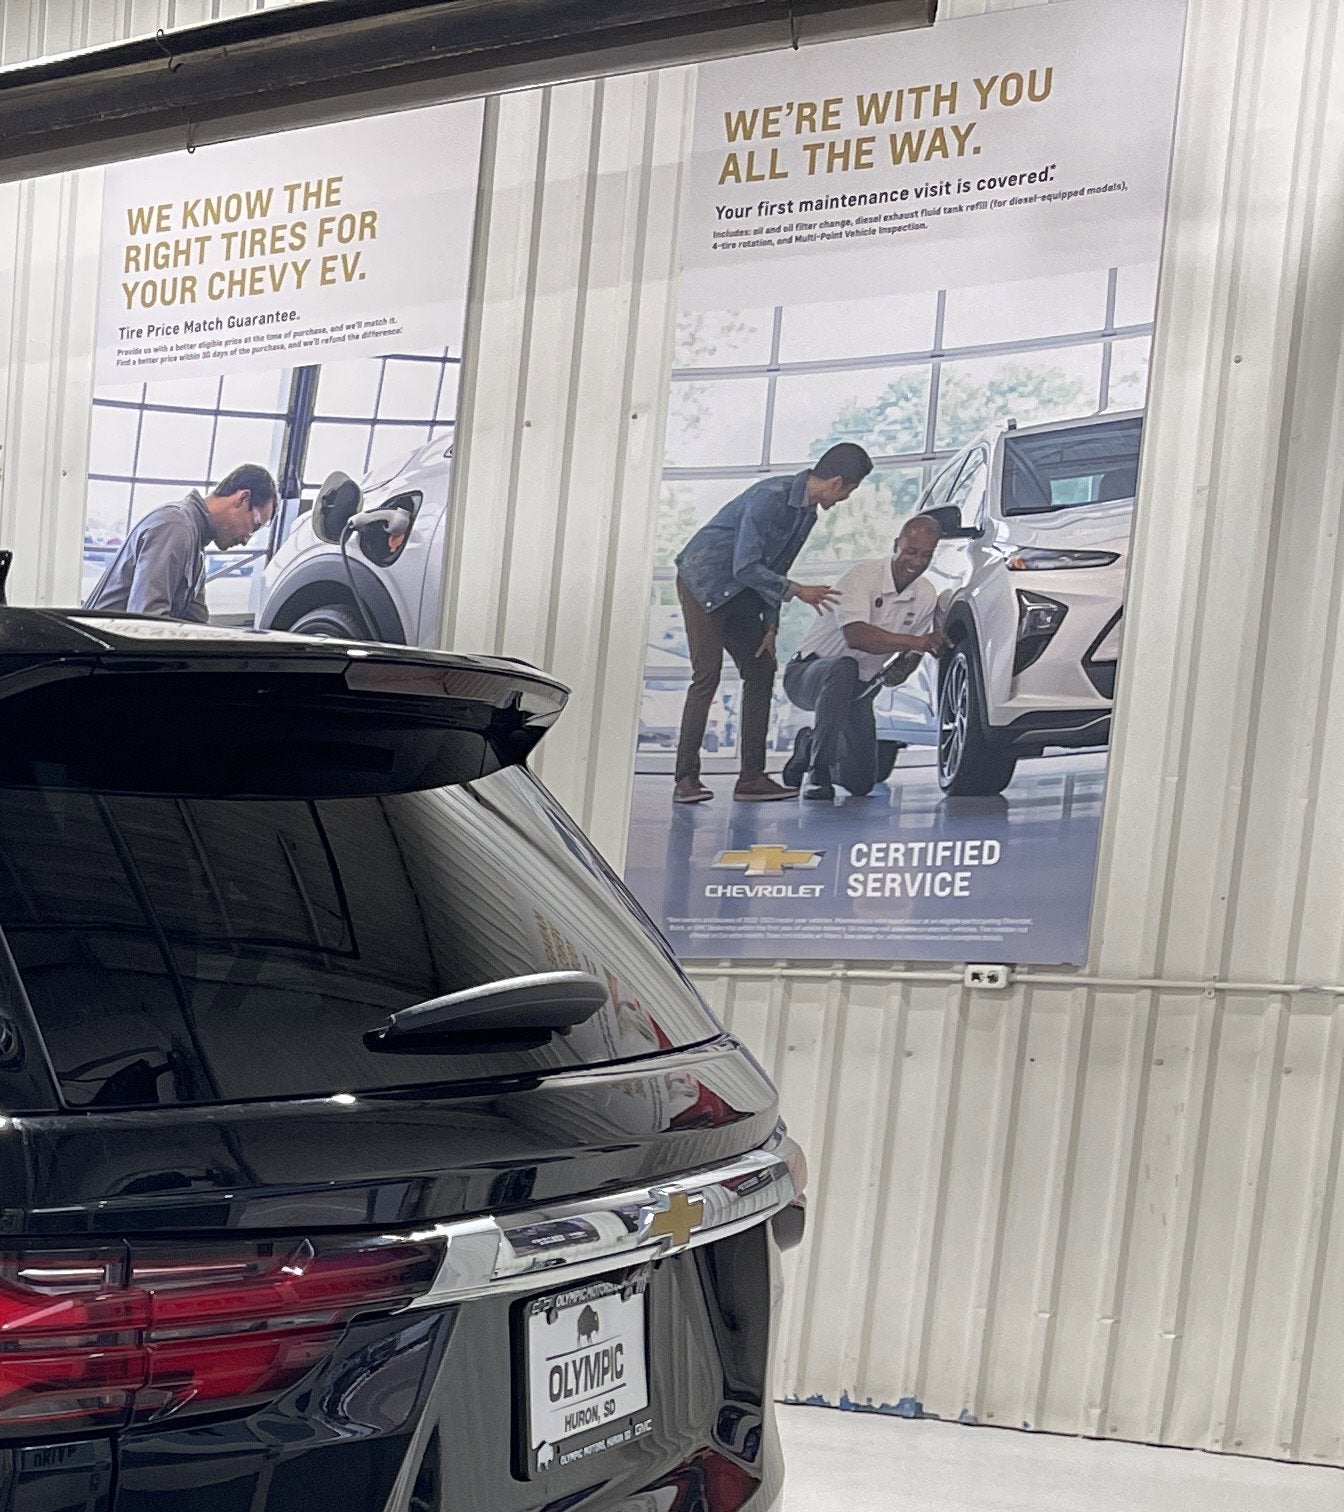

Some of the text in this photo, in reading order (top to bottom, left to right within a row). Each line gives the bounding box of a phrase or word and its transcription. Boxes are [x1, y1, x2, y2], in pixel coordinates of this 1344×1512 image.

[724, 66, 1053, 143] WE'RE WITH YOU
[718, 122, 981, 185] ALL THE WAY.
[127, 176, 343, 236] WE KNOW THE
[716, 205, 753, 220] Your
[757, 200, 794, 217] first
[799, 189, 909, 212] maintenance
[914, 180, 952, 198] visit
[956, 178, 971, 194] is
[765, 225, 781, 234] and
[855, 214, 881, 225] diesel
[883, 210, 918, 221] exhaust
[920, 207, 941, 217] fluid
[943, 205, 963, 214] tank
[776, 235, 793, 245] and
[844, 227, 876, 238] Vehicle
[125, 210, 377, 273] RIGHT TIRES FOR
[122, 251, 366, 310] YOUR CHEVY EV.
[119, 310, 300, 340] Tire Price Match Guarantee.
[153, 345, 168, 353] with
[849, 839, 1002, 868] CERTIFIED
[705, 884, 825, 898] CHEVROLET
[847, 871, 972, 898] SERVICE
[548, 1343, 624, 1403] OLYMPIC
[564, 1398, 616, 1433] HURON, SD
